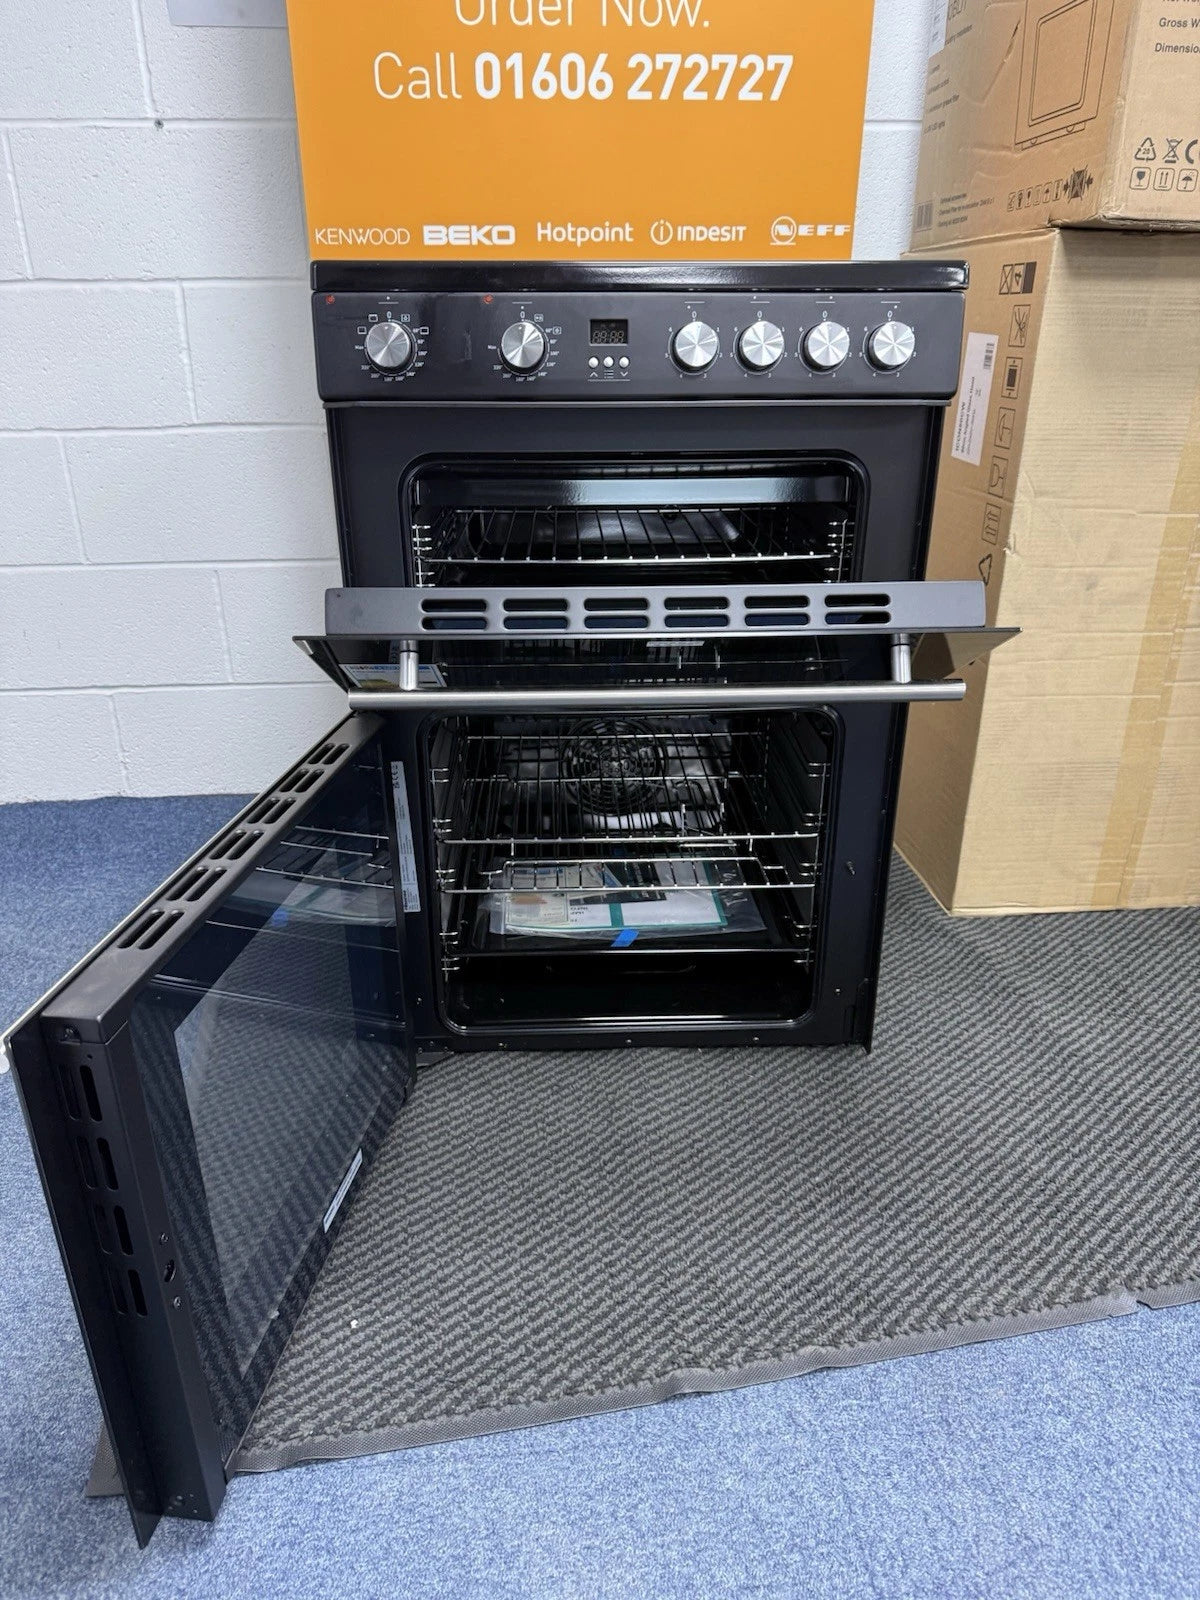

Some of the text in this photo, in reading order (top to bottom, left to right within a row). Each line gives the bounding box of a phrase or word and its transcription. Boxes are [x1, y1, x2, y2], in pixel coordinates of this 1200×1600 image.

[455, 0, 711, 28] Order Now.
[1159, 17, 1188, 28] Gross
[1154, 42, 1200, 54] Dimensio
[373, 51, 794, 102] Call 01606 272727
[422, 224, 516, 246] BEKO
[536, 220, 634, 247] Hotpoint
[772, 219, 851, 241] NEFF
[314, 227, 411, 246] KENWOOD
[387, 311, 392, 319] 0
[520, 311, 526, 319] 0
[691, 310, 697, 318] 0
[757, 310, 762, 318] 0
[822, 310, 828, 318] 0
[887, 310, 893, 318] 0
